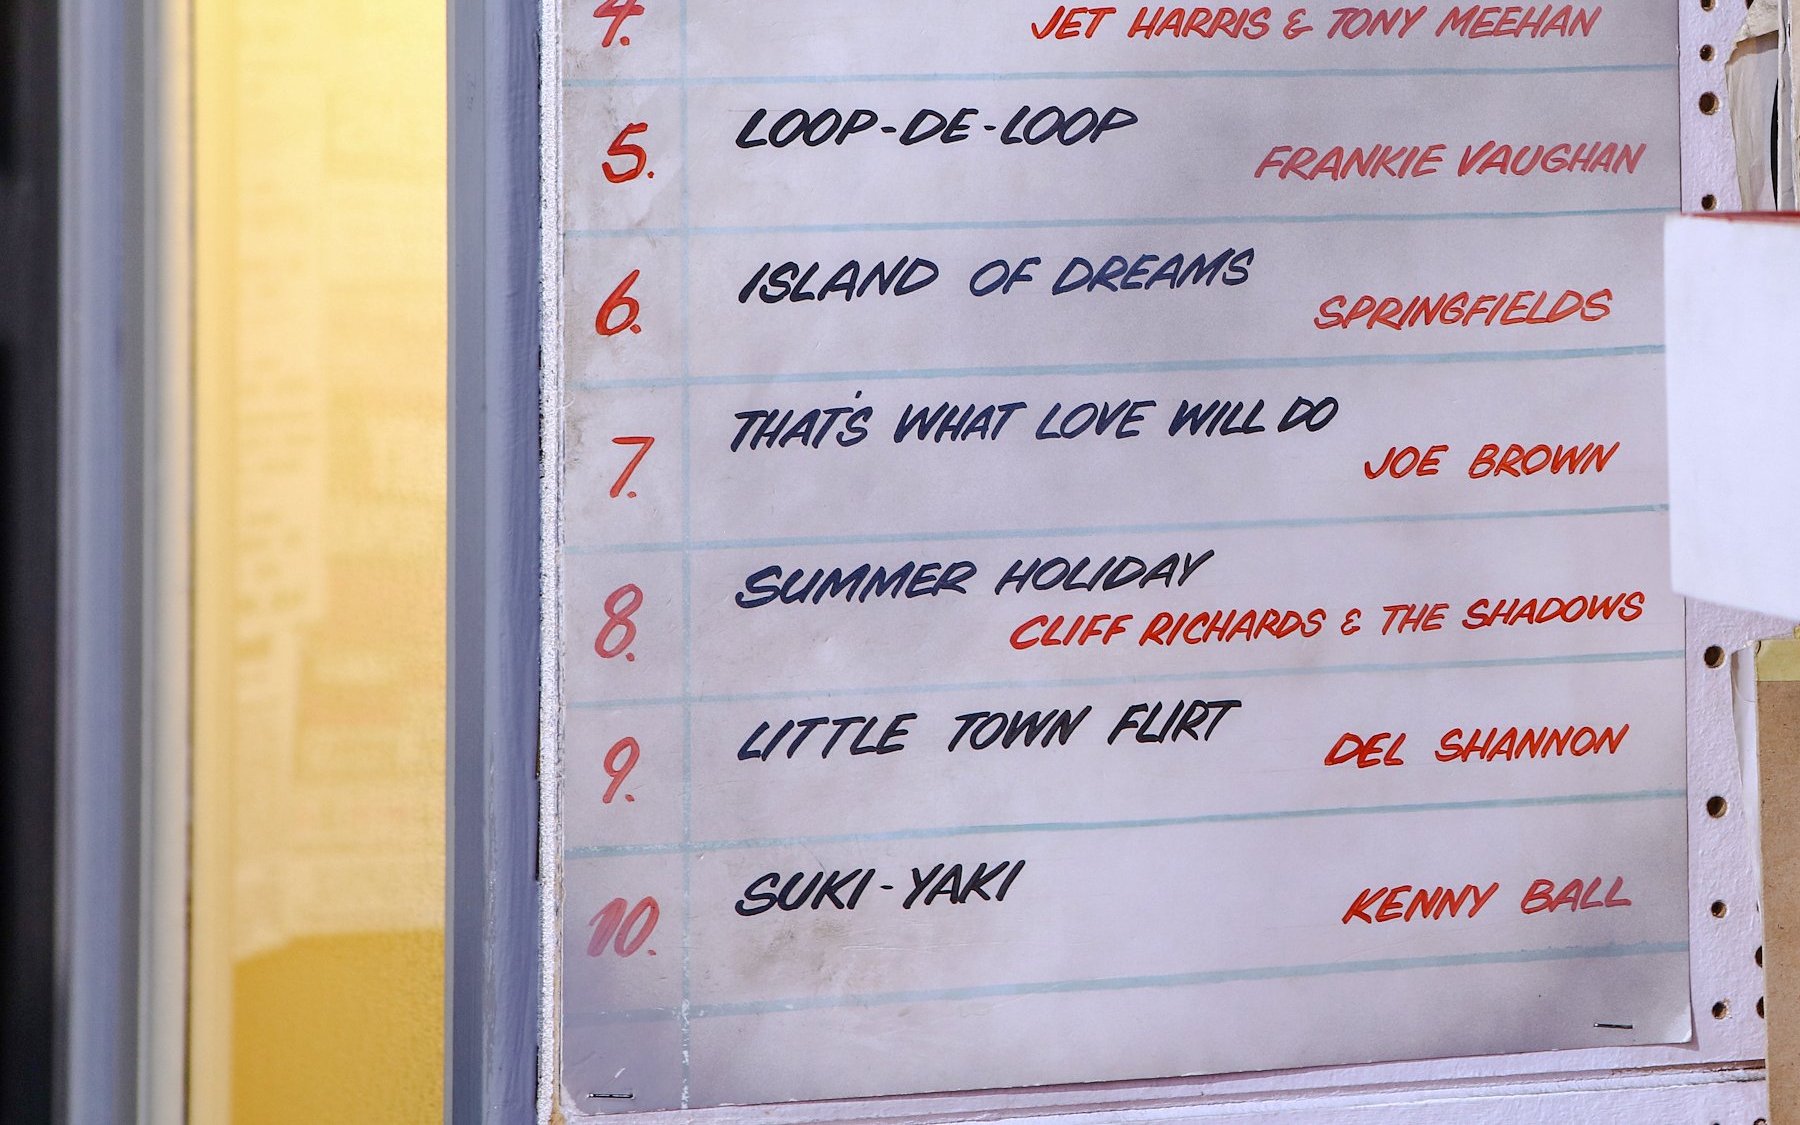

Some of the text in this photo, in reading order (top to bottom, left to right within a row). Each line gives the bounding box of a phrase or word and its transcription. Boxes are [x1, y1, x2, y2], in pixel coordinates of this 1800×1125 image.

[1030, 4, 1603, 41] JET HARRIS & TONY MEEHAN
[601, 121, 655, 185] 5.
[734, 105, 1139, 150] LOOP-DE-LOOP
[1253, 140, 1647, 182] FRANKIE VAUGHAN
[594, 268, 642, 338] 6.
[737, 247, 1255, 304] ISLAND OF DREAMS
[1313, 287, 1614, 331] SPRINGFIELDS
[729, 390, 1339, 453] THAT'S WHAT LOVE WILL DO
[608, 435, 656, 499] 7.
[1363, 441, 1621, 481] JOE BROWN
[734, 548, 1216, 610] SUMMER HOLIDAY
[593, 583, 644, 662] 8.
[1008, 590, 1646, 651] CLIFF RICHARDS & THE SHADOWS
[736, 699, 1243, 762] LITTLE TOWN FLIRT
[1323, 723, 1631, 770] DEL SHANNON
[602, 735, 641, 804] 9.
[734, 859, 1026, 917] SUKI-YAKI
[1340, 876, 1633, 925] KENNY BALL
[586, 896, 660, 958] 10.
